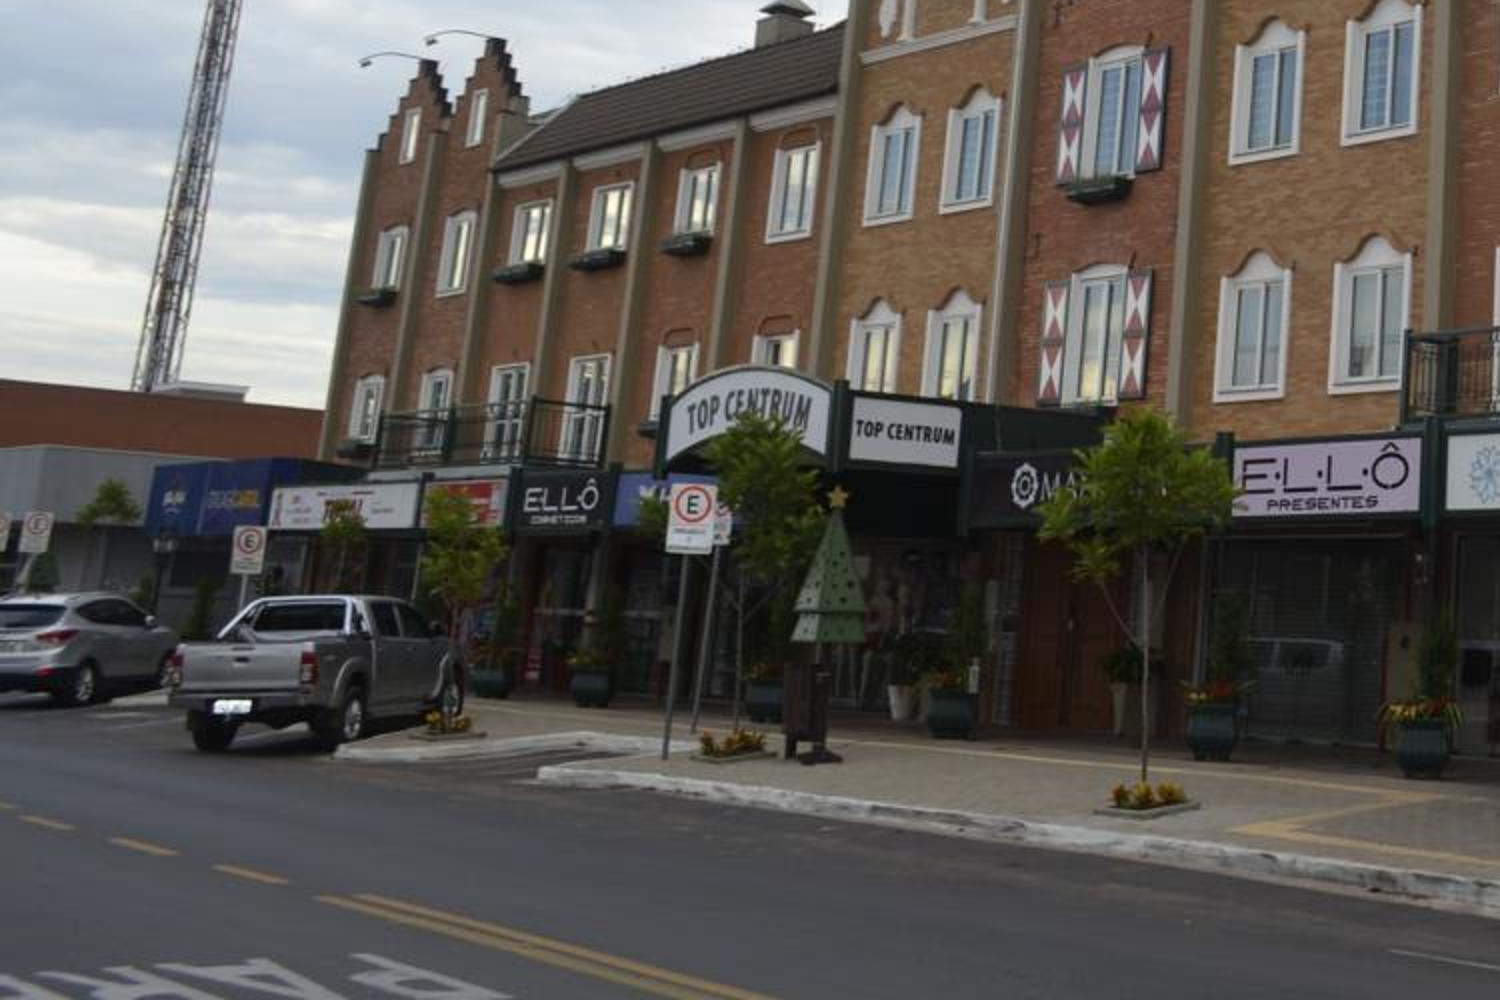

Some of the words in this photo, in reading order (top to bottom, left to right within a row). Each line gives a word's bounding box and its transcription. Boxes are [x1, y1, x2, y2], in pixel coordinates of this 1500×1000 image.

[688, 394, 719, 434] TOP
[724, 387, 813, 432] CENTRUM
[856, 419, 882, 437] TOP
[887, 422, 955, 446] CENTRUM
[687, 495, 700, 514] E
[1266, 495, 1379, 511] PRESENTES
